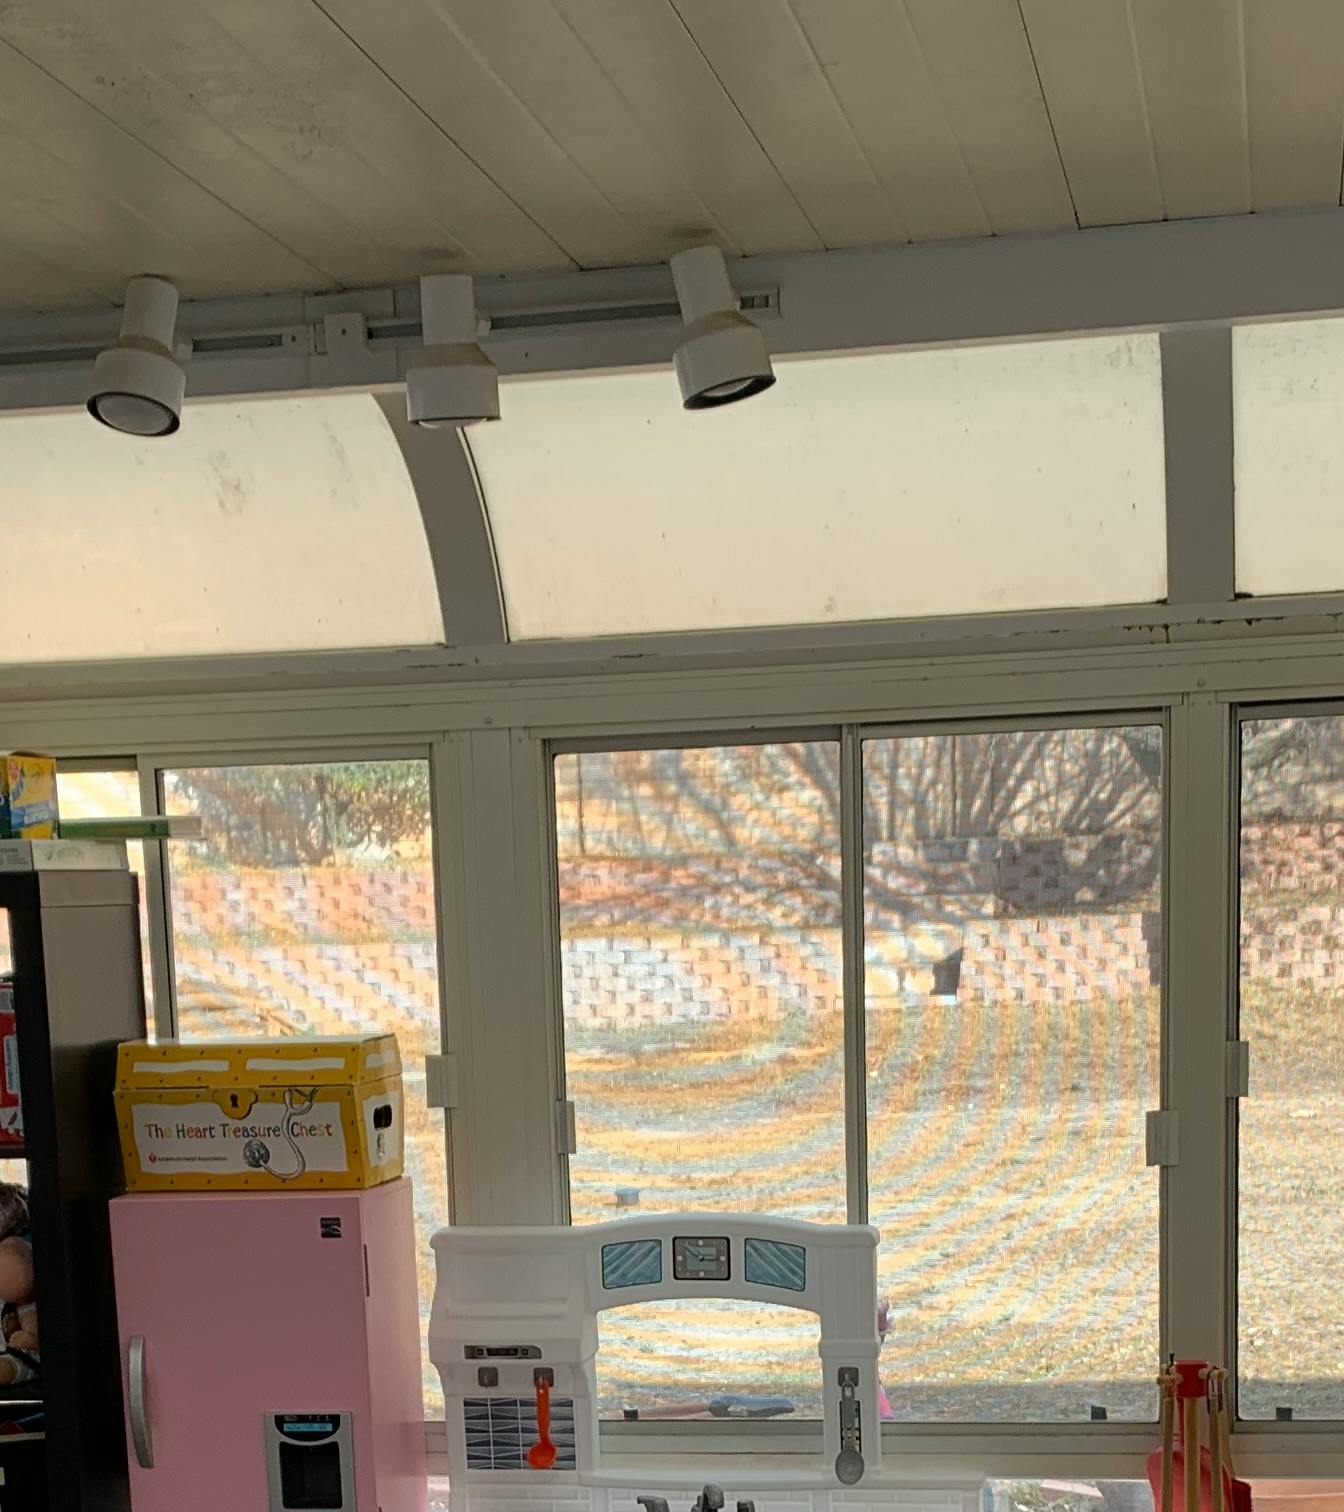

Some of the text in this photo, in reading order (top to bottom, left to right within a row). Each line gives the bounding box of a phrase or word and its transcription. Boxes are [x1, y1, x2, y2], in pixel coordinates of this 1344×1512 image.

[144, 1123, 333, 1140] The Heart Treasure Chest
